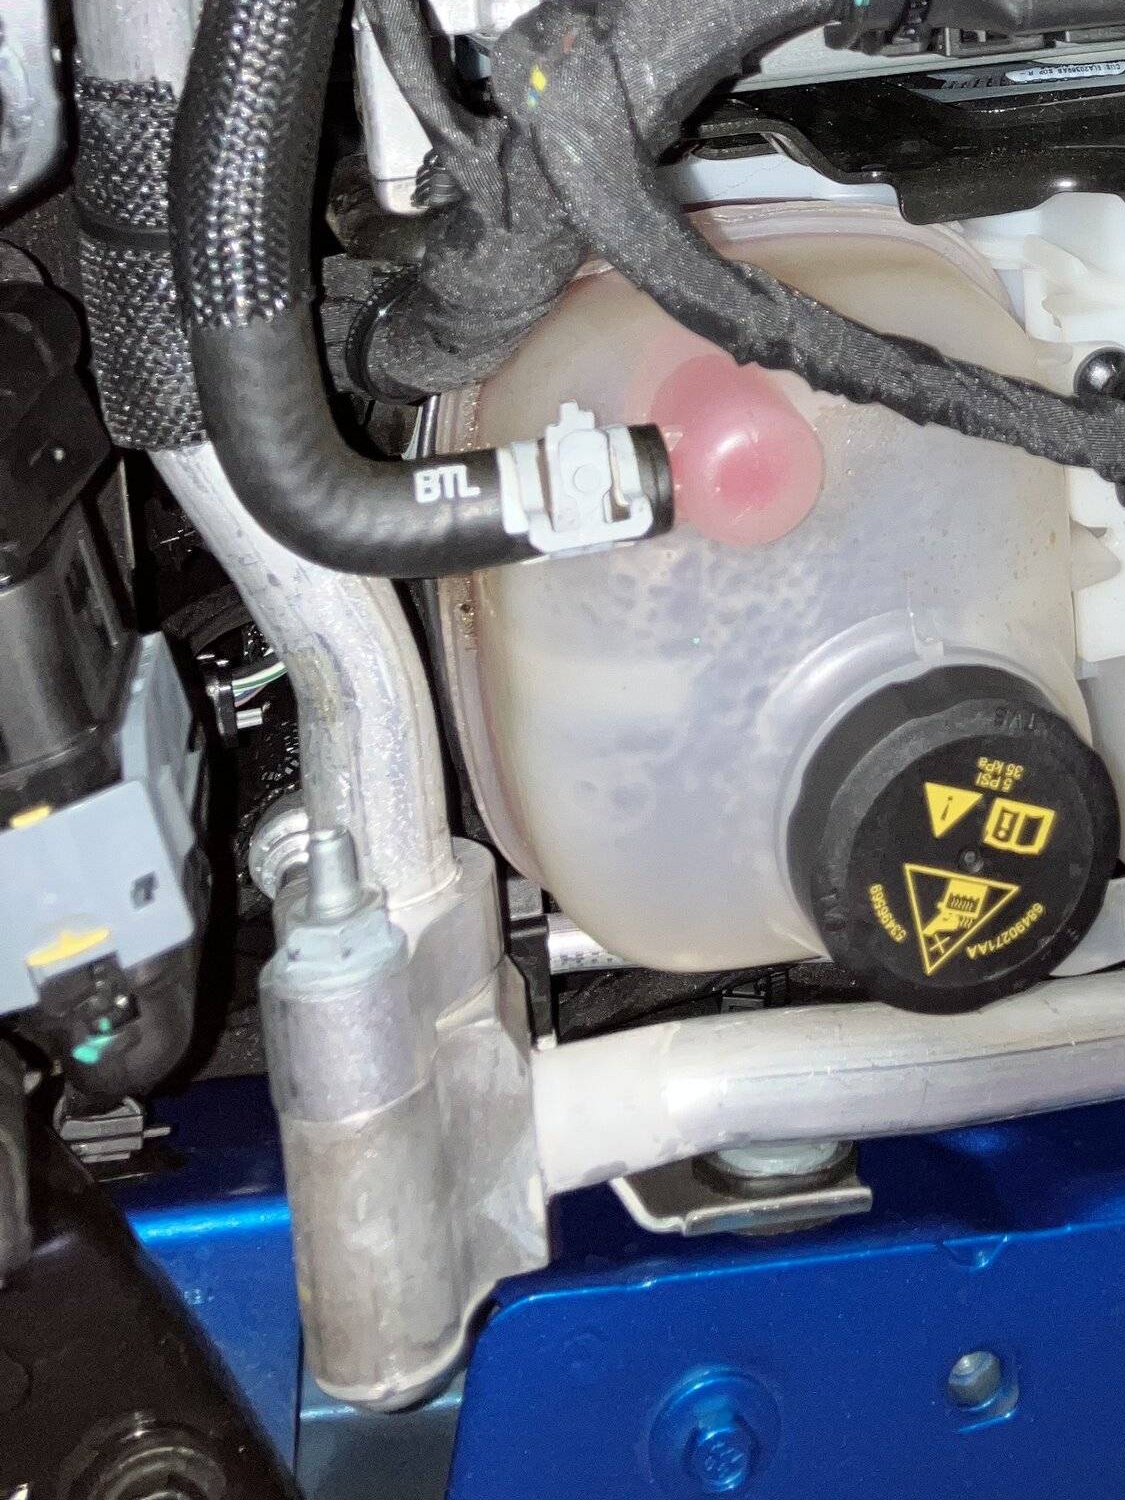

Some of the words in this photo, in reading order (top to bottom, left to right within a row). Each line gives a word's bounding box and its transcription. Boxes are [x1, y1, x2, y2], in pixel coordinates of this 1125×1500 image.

[414, 465, 481, 503] BTL
[977, 757, 1004, 775] kPa
[1005, 764, 1024, 779] 35
[975, 772, 1001, 788] PSI
[1003, 777, 1014, 790] 5
[966, 901, 1045, 960] 68490271AA
